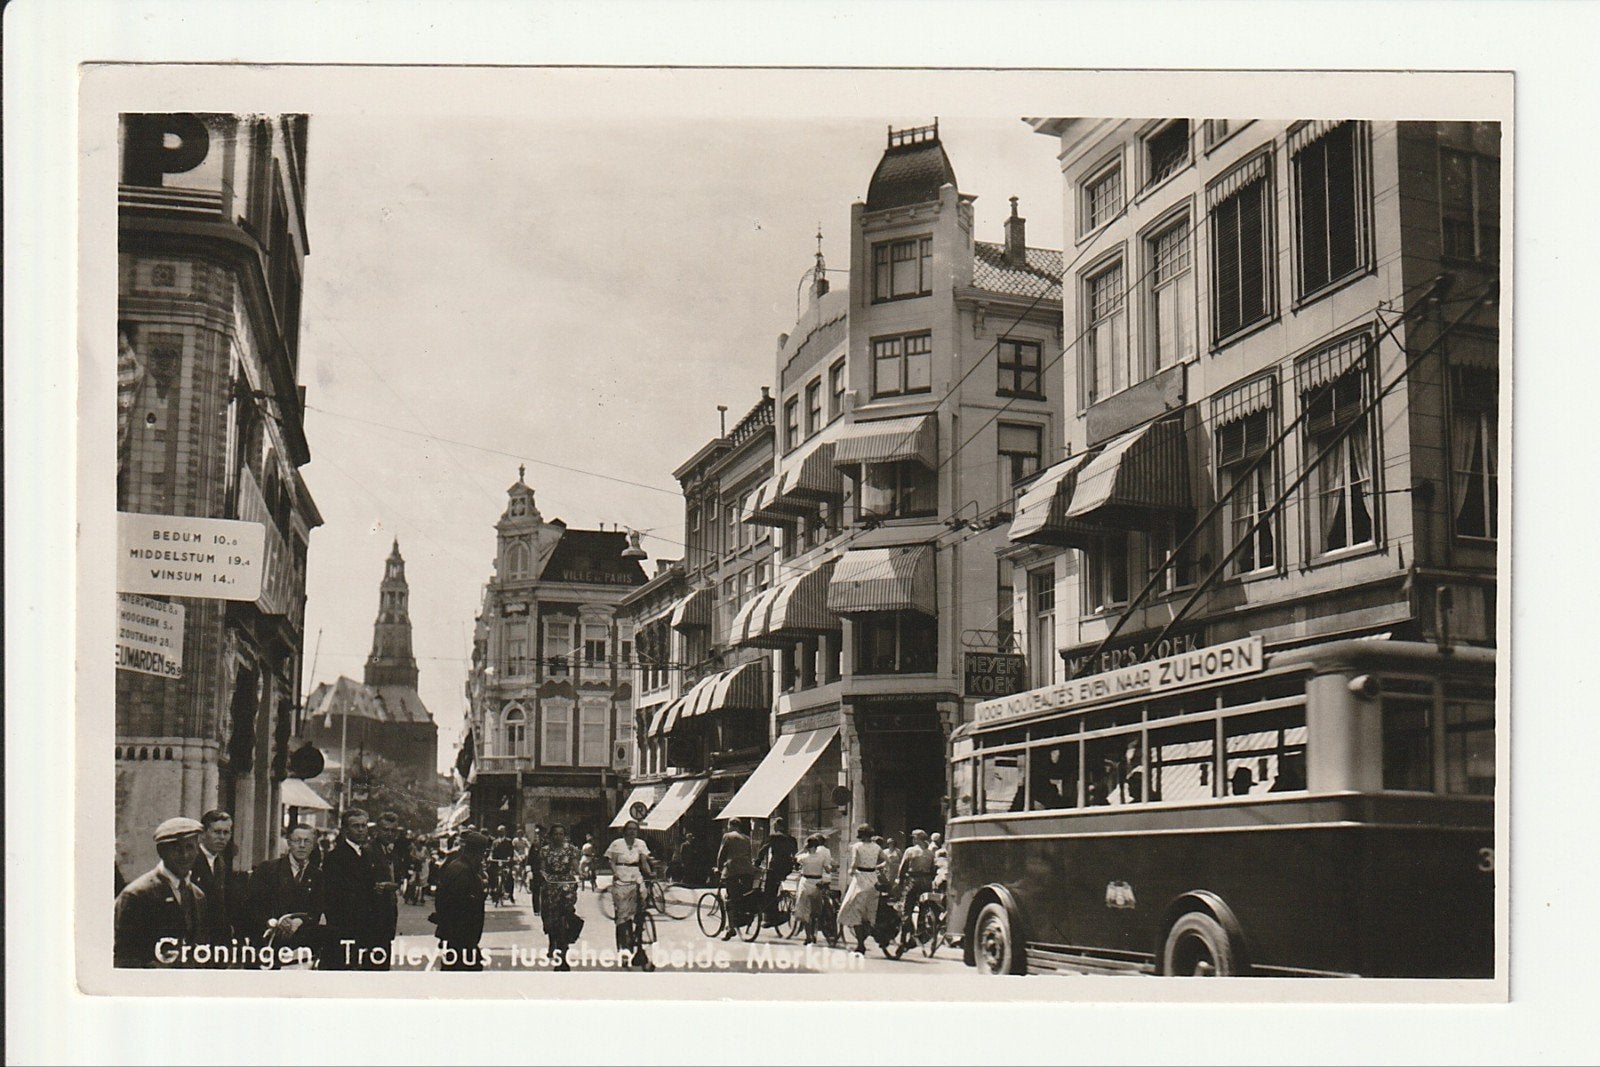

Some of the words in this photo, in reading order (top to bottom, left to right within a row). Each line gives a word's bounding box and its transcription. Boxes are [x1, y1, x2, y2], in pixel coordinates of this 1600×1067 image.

[153, 530, 202, 543] BEDUM
[130, 549, 215, 563] MIDDELSTUM
[151, 569, 202, 582] WINSUM
[604, 572, 633, 584] PARIS
[120, 628, 157, 645] ZOUTKAMP
[1080, 680, 1110, 700] EVEN
[1116, 669, 1150, 692] NAAR
[1159, 643, 1252, 685] ZUHORN
[970, 675, 1017, 694] KOEK
